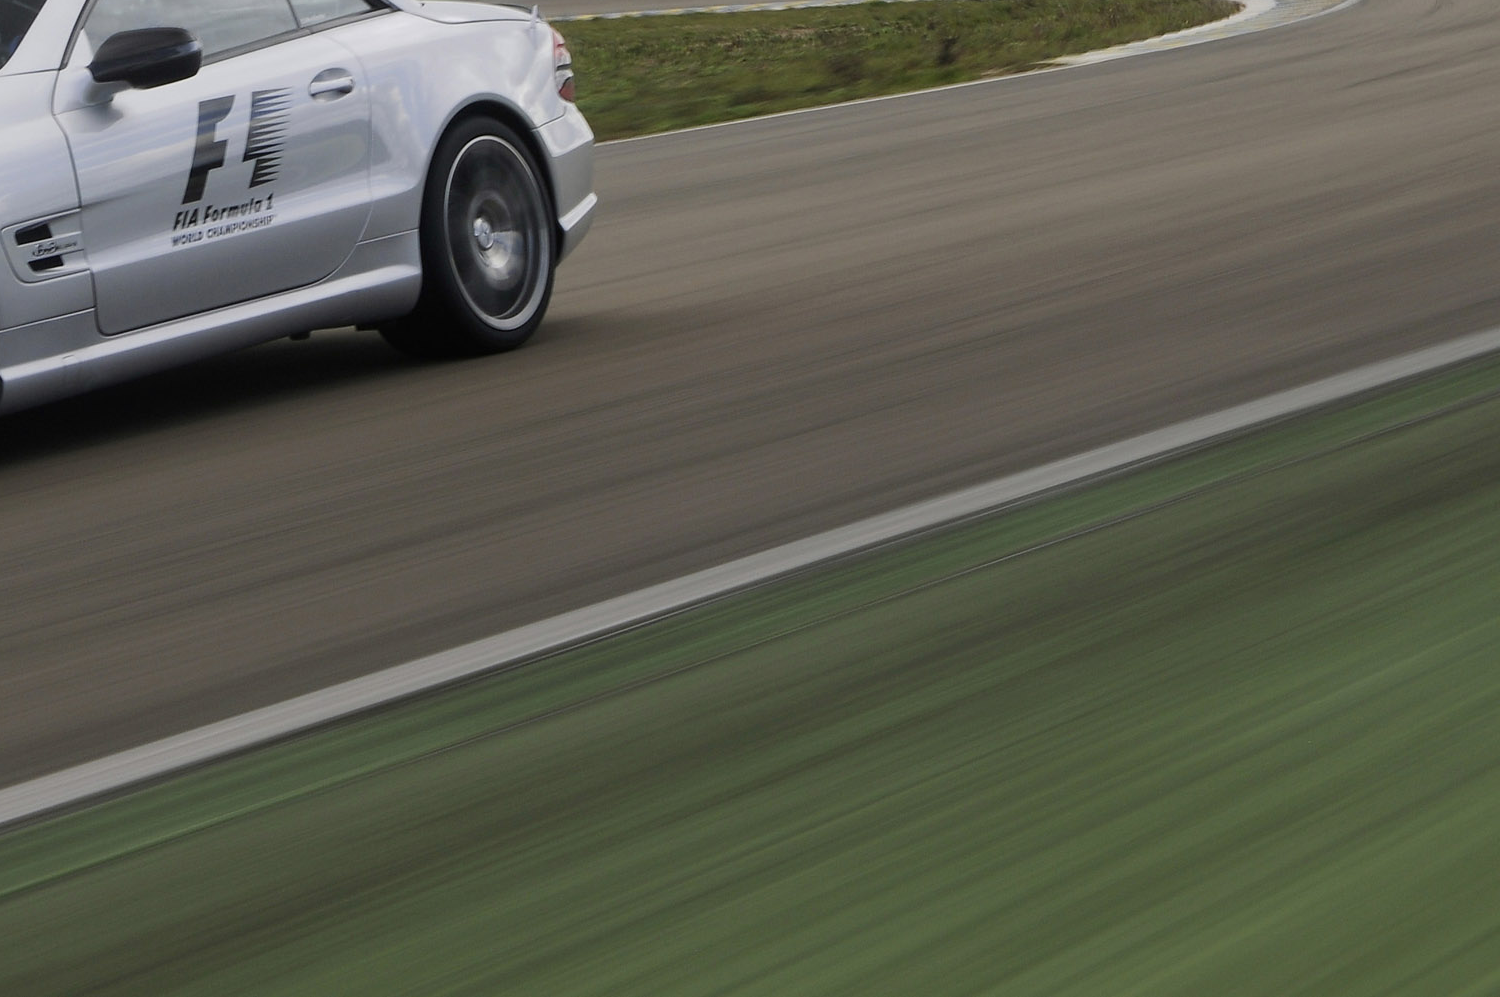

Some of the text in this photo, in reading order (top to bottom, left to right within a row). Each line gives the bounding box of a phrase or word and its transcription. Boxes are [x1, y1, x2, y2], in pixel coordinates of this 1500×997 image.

[181, 87, 293, 205] F1
[171, 214, 276, 246] WORLD CHAMPIONSHIP
[173, 192, 274, 232] FIA Formula 1
